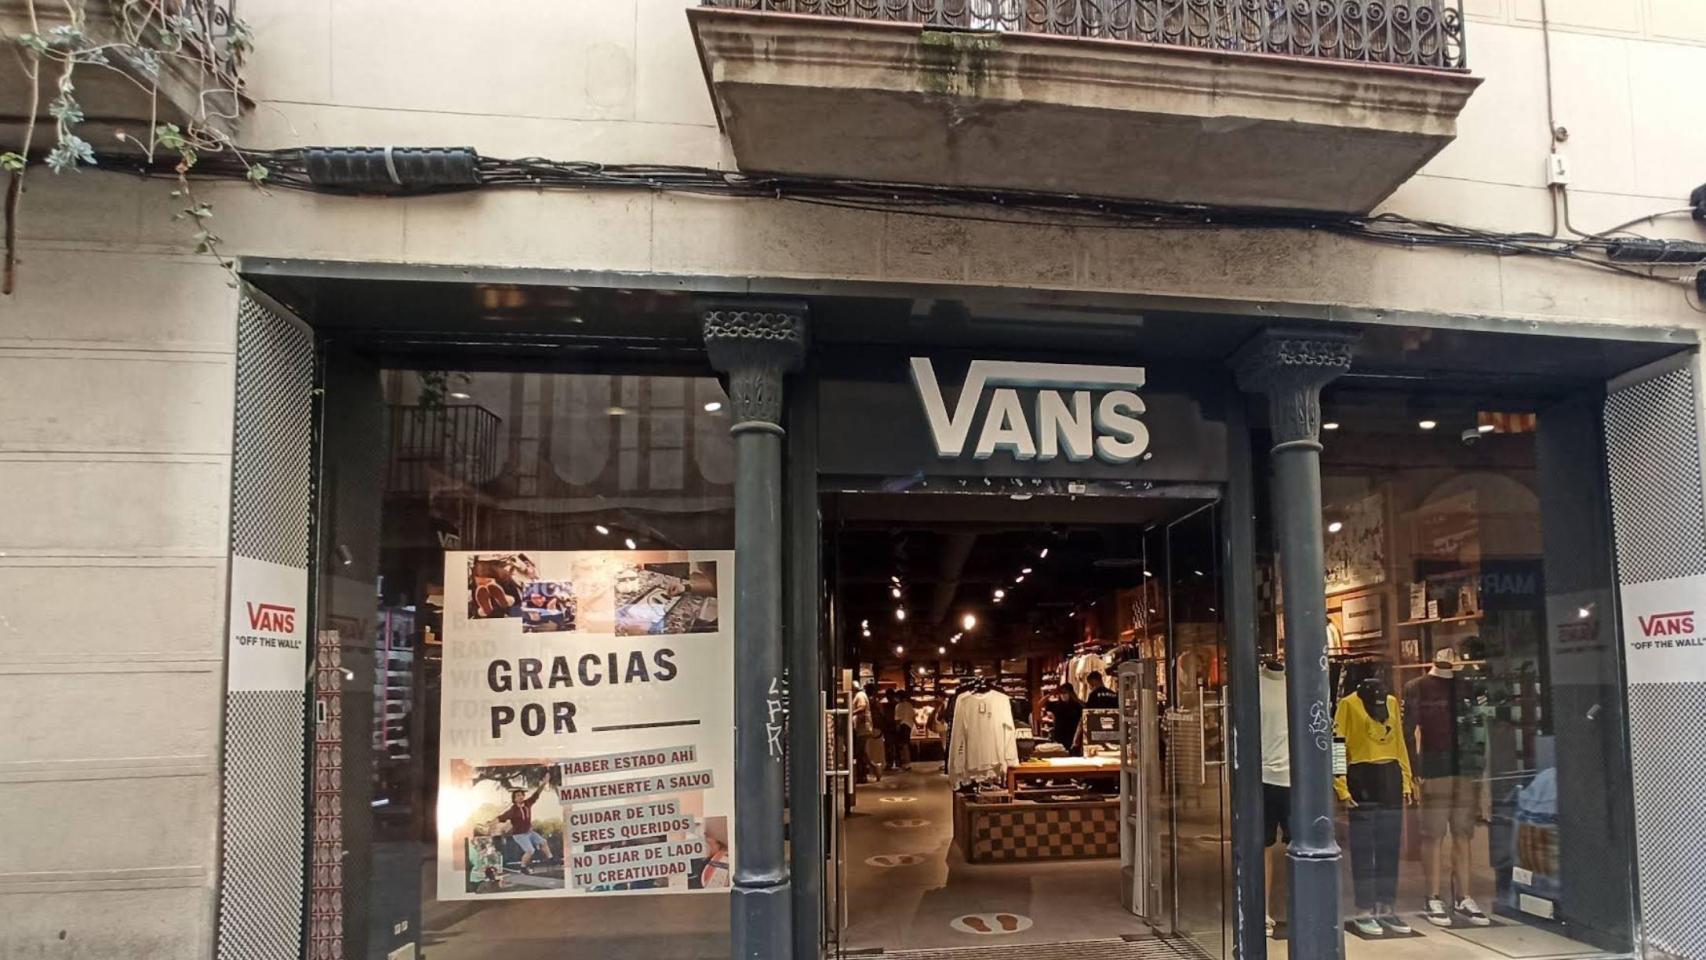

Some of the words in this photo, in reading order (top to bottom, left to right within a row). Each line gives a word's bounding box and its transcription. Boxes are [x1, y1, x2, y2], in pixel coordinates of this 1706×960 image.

[910, 356, 1150, 464] VANS
[246, 601, 296, 634] VANS
[1638, 610, 1695, 637] VANS
[259, 637, 277, 648] THE
[1654, 640, 1674, 649] THE
[487, 648, 678, 693] GRACIAS
[490, 700, 578, 739] POR
[564, 759, 610, 775] HABER
[614, 752, 666, 769] ESTADO
[560, 779, 652, 801] MANTENERTE
[656, 778, 665, 791] A
[669, 773, 711, 789] SALVO
[570, 809, 621, 826] CUIDAR
[626, 806, 645, 819] DE
[649, 803, 675, 817] TUS
[572, 827, 615, 844] SERES
[620, 818, 690, 838] QUERIDOS
[573, 855, 593, 869] NO
[599, 849, 640, 866] DEJAR
[645, 847, 663, 861] DE
[668, 842, 703, 858] LADO
[575, 873, 593, 886] TU
[599, 861, 686, 882] CREATIVIDAD
